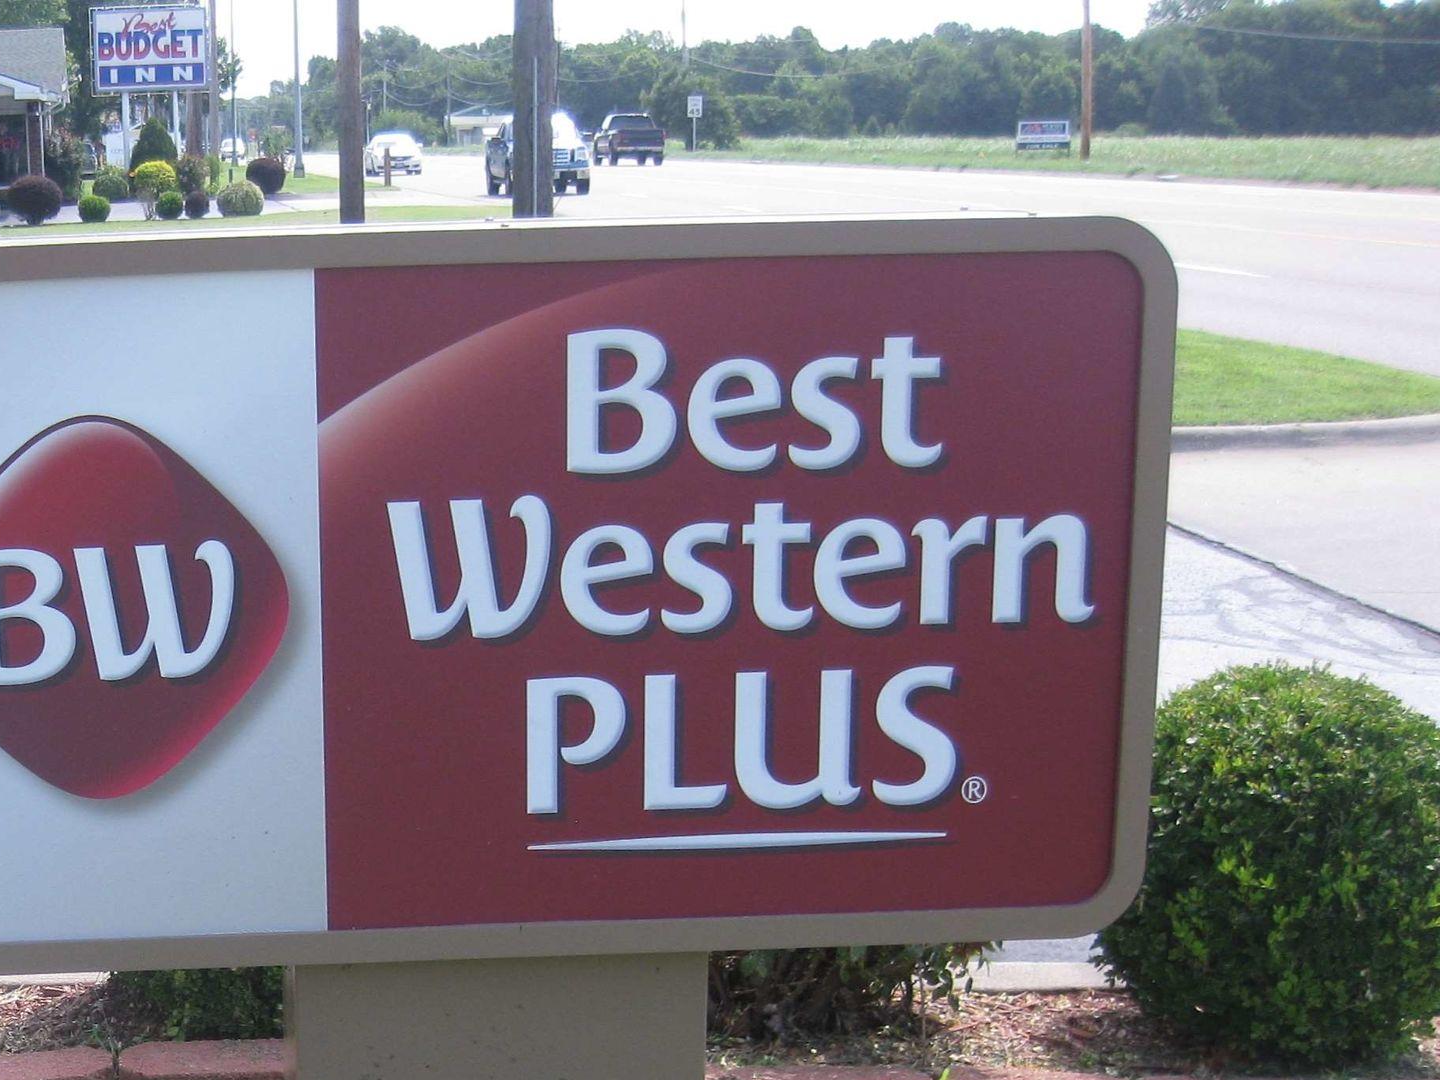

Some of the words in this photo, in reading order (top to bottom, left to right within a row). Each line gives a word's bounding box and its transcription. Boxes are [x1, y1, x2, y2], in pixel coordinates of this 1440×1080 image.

[97, 29, 203, 61] BUDGET
[122, 12, 176, 38] Best
[110, 66, 193, 84] INN
[566, 328, 942, 472] Best
[386, 494, 1096, 641] Western
[526, 665, 957, 814] PLUS
